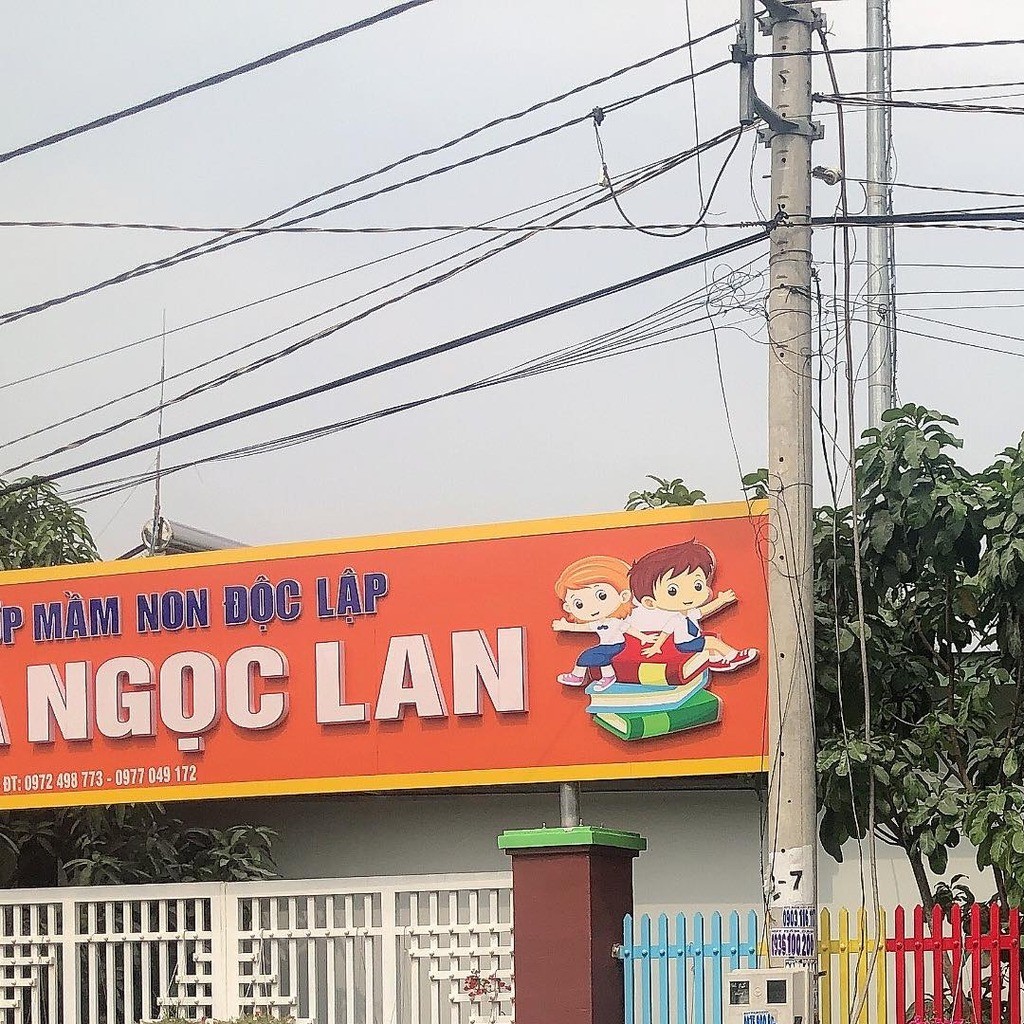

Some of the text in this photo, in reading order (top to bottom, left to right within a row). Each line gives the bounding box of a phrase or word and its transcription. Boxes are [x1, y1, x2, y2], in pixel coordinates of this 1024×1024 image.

[33, 591, 121, 642] MẦM
[136, 587, 210, 633] NON
[223, 575, 302, 632] ĐỘC
[316, 567, 389, 624] LẬP
[26, 645, 290, 754] NGỌC
[315, 627, 528, 726] LAN
[3, 774, 21, 793] ĐT:
[25, 772, 53, 791] 0972
[56, 771, 78, 789] 498
[81, 770, 104, 787] 773
[115, 767, 145, 786] 0977
[148, 765, 171, 784] 049
[174, 764, 197, 782] 172
